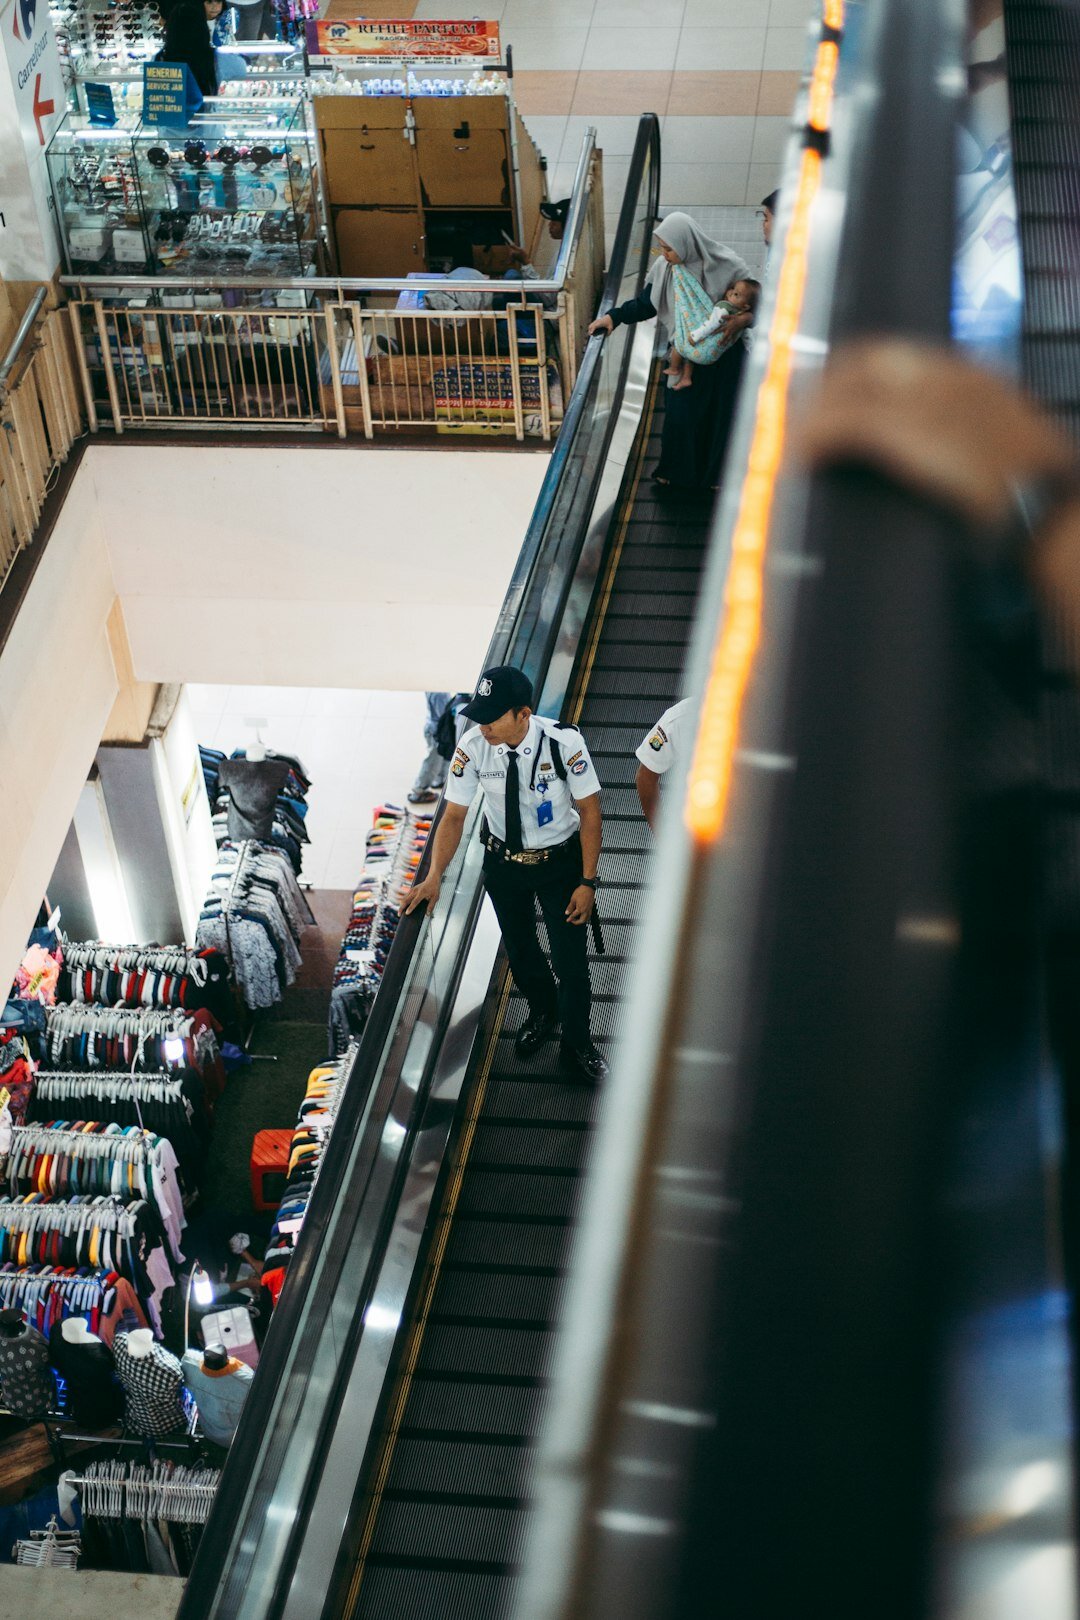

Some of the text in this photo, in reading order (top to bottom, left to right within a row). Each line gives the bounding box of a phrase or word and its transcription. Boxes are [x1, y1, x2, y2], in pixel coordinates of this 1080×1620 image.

[358, 23, 409, 34] REFILL
[413, 23, 477, 34] PARFUM
[17, 31, 48, 90] Carrefour
[146, 67, 183, 79] MENERIMA
[146, 82, 183, 91] SERVICE JAM
